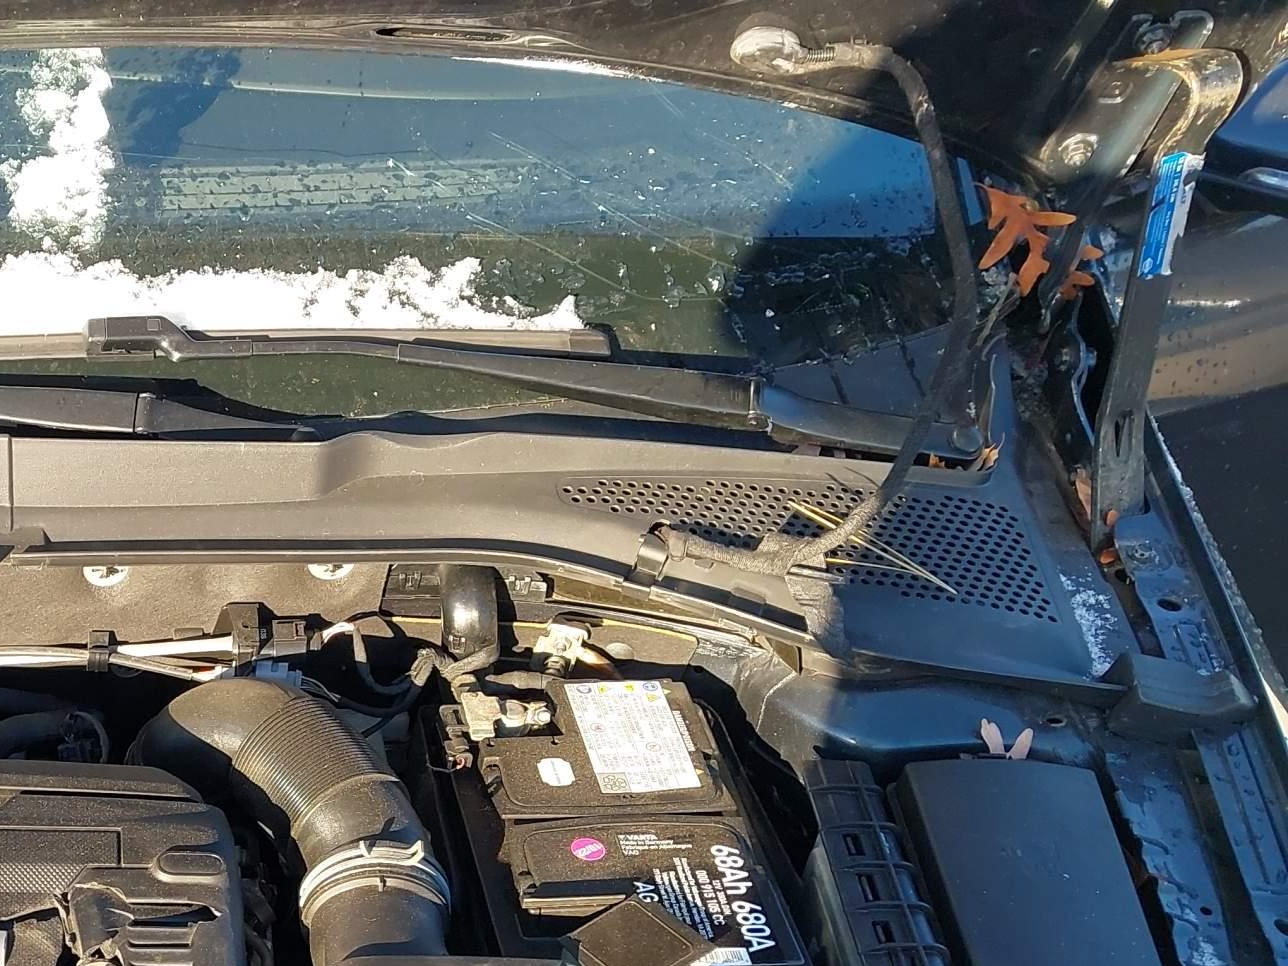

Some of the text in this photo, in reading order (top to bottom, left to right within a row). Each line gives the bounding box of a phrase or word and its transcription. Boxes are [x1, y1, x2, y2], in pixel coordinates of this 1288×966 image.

[695, 870, 724, 925] 000 915 105 CC
[710, 844, 776, 953] 68Ah 680A
[711, 879, 722, 889] 12V
